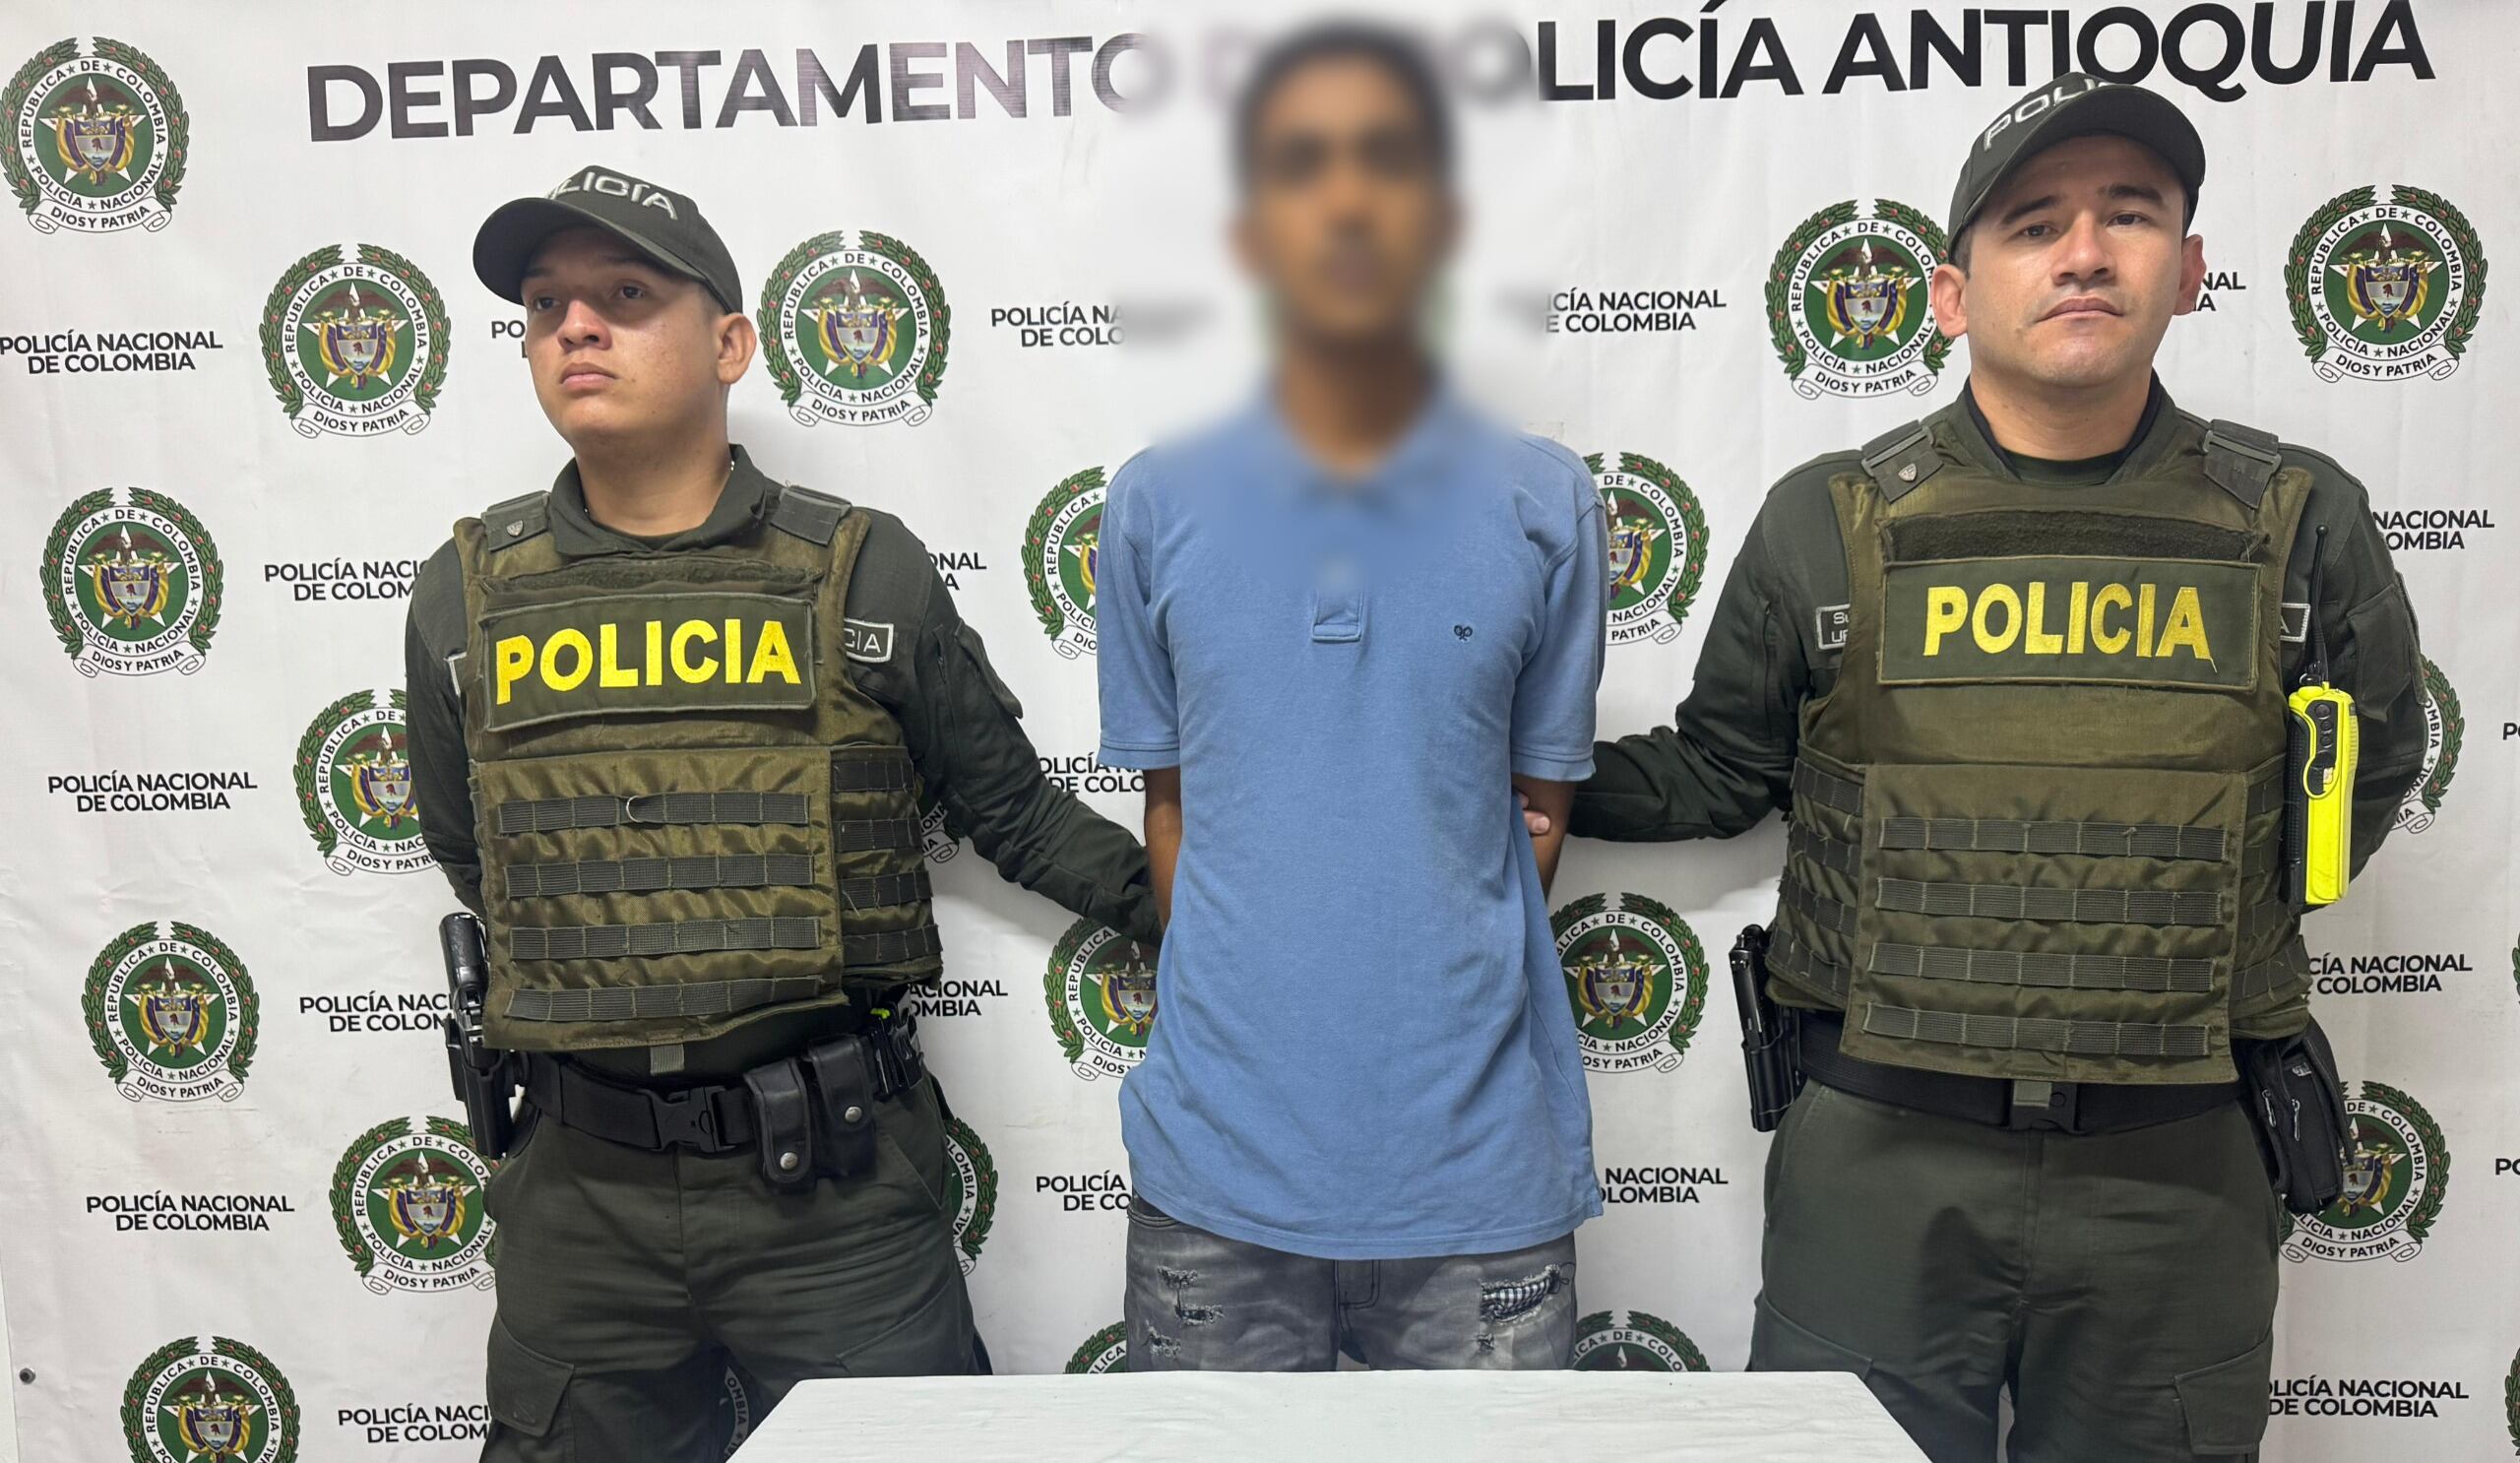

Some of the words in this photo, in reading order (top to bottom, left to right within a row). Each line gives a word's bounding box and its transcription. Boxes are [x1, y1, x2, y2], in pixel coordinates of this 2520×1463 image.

[1822, 0, 2436, 102] ANTIOQUIA
[306, 32, 1176, 143] DEPARTAMENTO
[80, 61, 99, 71] DE
[117, 68, 166, 144] COLOMBIA
[99, 162, 161, 210] NACIONAL
[100, 206, 148, 228] PATRIA
[1857, 223, 1878, 233] DE
[2376, 207, 2397, 218] DE
[2415, 215, 2462, 291] COLOMBIA
[844, 252, 866, 264] DE
[879, 260, 929, 338] COLOMBIA
[1600, 289, 1727, 311] NACIONAL
[343, 267, 363, 277] DE
[380, 274, 427, 349] COLOMBIA
[991, 301, 1087, 327] POLICÍA
[1565, 312, 1696, 333] COLOMBIA
[2387, 309, 2455, 357] NACIONAL
[0, 329, 92, 354] POLICÍA
[97, 331, 223, 351] NACIONAL
[1021, 329, 1053, 347] DE
[1865, 325, 1933, 374] NACIONAL
[28, 355, 60, 374] DE
[65, 352, 196, 372] COLOMBIA
[2386, 353, 2437, 376] PATRIA
[360, 366, 422, 413] NACIONAL
[861, 355, 924, 403] NACIONAL
[1864, 370, 1915, 394] PATRIA
[361, 410, 409, 432] PATRIA
[861, 400, 910, 421] PATRIA
[1602, 476, 1622, 486] DE
[1639, 483, 1685, 557] COLOMBIA
[114, 510, 134, 521] DE
[152, 517, 201, 591] COLOMBIA
[2386, 531, 2465, 550] OMBIA
[265, 557, 357, 582] POLICÍA
[363, 560, 418, 579] NACI
[293, 583, 326, 601] DE
[332, 581, 413, 601] COLOM
[1612, 575, 1677, 622] NACIONAL
[136, 607, 197, 654] NACIONAL
[1611, 618, 1661, 641] PATRIA
[1922, 581, 2214, 661] POLICIA
[1073, 632, 1098, 651] DIO
[137, 650, 184, 671] PATRIA
[495, 618, 802, 705] POLICIA
[375, 711, 395, 721] DE
[2424, 698, 2440, 748] OMBIA
[1040, 752, 1110, 774] OLICÍA
[48, 770, 134, 794] POLICÍA
[137, 772, 258, 792] NACIONAL
[1085, 776, 1145, 793] COLO
[77, 795, 106, 812] DE
[110, 793, 230, 811] COLOMBIA
[395, 854, 432, 870] PATRI
[1605, 914, 1624, 924] DE
[1641, 922, 1685, 991] COLOMBIA
[2351, 954, 2473, 975] NACIONAL
[158, 942, 177, 953] DE
[192, 950, 238, 1021] COLOMBIA
[2316, 974, 2442, 995] COLOMBIA
[299, 990, 393, 1014] POLICÍA
[398, 993, 452, 1011] NACI
[329, 1015, 361, 1032] DE
[1615, 1008, 1678, 1051] NACIONAL
[179, 1038, 234, 1080] NACIONAL
[1615, 1049, 1663, 1069] PATRIA
[180, 1078, 222, 1098] PATRIA
[411, 1136, 431, 1146] DE
[2347, 1102, 2365, 1113] DE
[2380, 1110, 2426, 1180] COLOMBIA
[1036, 1170, 1126, 1193] POLICÍA
[1606, 1167, 1729, 1184] NACIONAL
[87, 1190, 177, 1213] POLICÍA
[181, 1195, 295, 1212] NACIONAL
[1063, 1194, 1095, 1211] DE
[1602, 1185, 1699, 1203] LOMBIA
[116, 1214, 149, 1231] DE
[153, 1213, 270, 1231] COLOMBIA
[2352, 1197, 2418, 1240] NACIONAL
[431, 1228, 492, 1272] NACIONAL
[2351, 1238, 2400, 1258] PATRIA
[432, 1268, 479, 1289] PATRIA
[1613, 1331, 1632, 1341] DE
[199, 1357, 218, 1367] DE
[233, 1364, 280, 1431] COLOMBIA
[2339, 1379, 2469, 1399] NACIONAL
[338, 1403, 430, 1426] POLICÍA
[435, 1405, 489, 1422] NACI
[2269, 1398, 2300, 1416] DE
[2303, 1398, 2438, 1418] COLOMBIA
[367, 1427, 399, 1443] DE
[404, 1424, 487, 1441] COLOM
